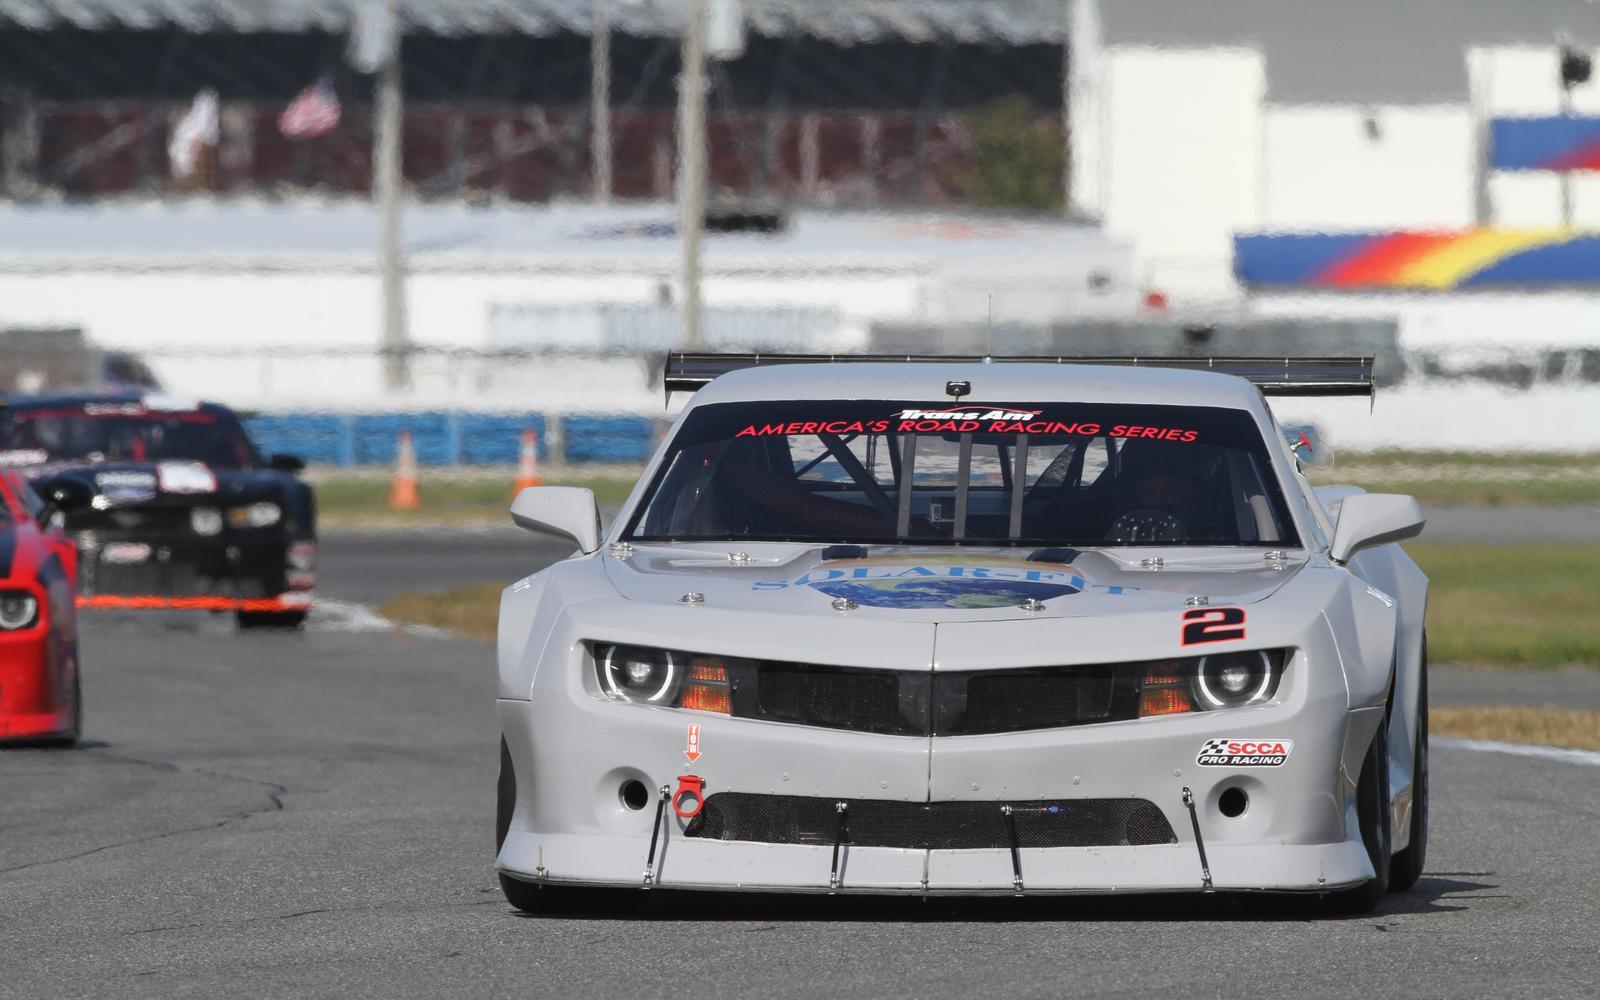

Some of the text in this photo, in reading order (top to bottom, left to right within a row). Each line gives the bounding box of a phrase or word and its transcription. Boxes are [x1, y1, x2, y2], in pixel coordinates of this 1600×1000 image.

[900, 409, 1034, 421] Trans Am
[735, 420, 1199, 443] AMERICA'S ROAD RACING SERIES
[1181, 607, 1247, 647] 2
[689, 725, 698, 753] TOW
[1227, 743, 1286, 755] SCCA
[1200, 756, 1283, 765] PRO RACING
